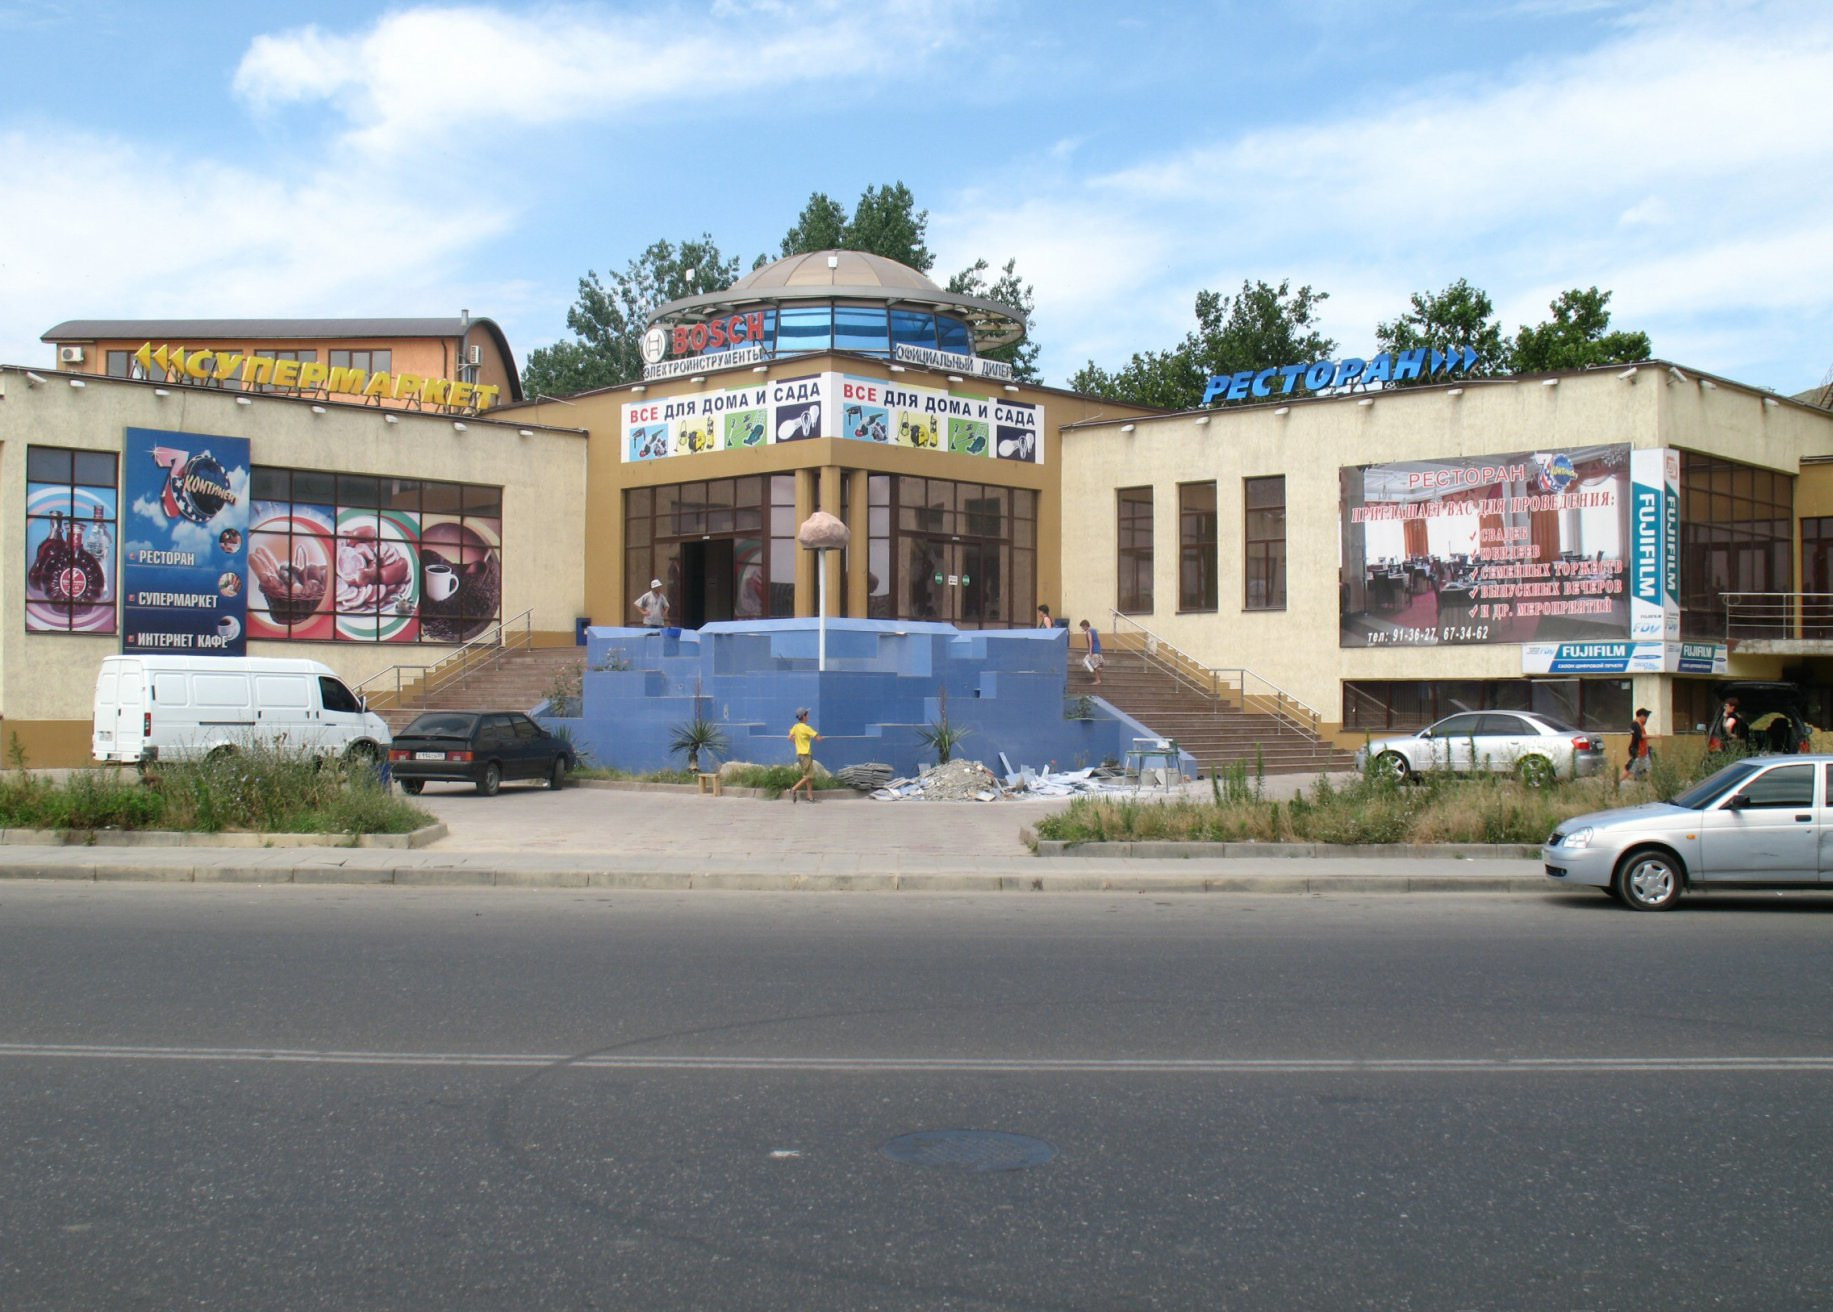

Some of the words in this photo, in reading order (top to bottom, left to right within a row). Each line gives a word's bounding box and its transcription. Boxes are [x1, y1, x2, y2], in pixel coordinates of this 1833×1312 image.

[673, 312, 764, 354] BOSCH
[643, 348, 763, 379] ЭЛЕКТРОИНСТРУМЕНТЫ
[896, 346, 974, 372] ОФИЦИАЛЬНЫЙ
[981, 360, 1012, 378] ДИЛЕР
[185, 349, 500, 410] СУПЕРМАРКЕТ
[1201, 347, 1428, 403] РЕСТОРАН
[630, 407, 659, 424] ВСЕ
[664, 400, 696, 421] ДЛЯ
[702, 393, 749, 415] ДОМА
[756, 390, 766, 405] И
[774, 382, 821, 403] САДА
[843, 384, 877, 402] ВСЕ
[884, 390, 918, 408] ДЛЯ
[925, 396, 972, 416] ДОМА
[978, 404, 988, 419] И
[994, 408, 1035, 427] САДА
[1408, 464, 1526, 489] РЕСТОРАН
[1351, 501, 1443, 523] ПРИГЛАШАЕТ
[1446, 500, 1474, 516] ВАС
[1479, 497, 1506, 518] ДЛЯ
[1510, 491, 1615, 514] ПРОВЕДЕНИЯ:
[1480, 526, 1528, 543] СВАДЕБ
[1639, 493, 1656, 597] FUJIFILM
[1667, 496, 1676, 591] FUJIFILM
[139, 550, 195, 565] РЕСТОРАН
[1480, 545, 1541, 560] ЮБИЛЕЕВ
[1480, 562, 1551, 580] СЕМЕЙНЫХ
[1552, 559, 1623, 577] ТОРЖЕСТВ
[138, 592, 218, 608] СУПЕРМАРКЕТ
[1480, 581, 1560, 599] ВЫПУСКНЫХ
[1563, 579, 1623, 596] ВЕЧЕРОВ
[1480, 604, 1489, 618] И
[1492, 603, 1513, 621] ДР.
[1517, 596, 1613, 617] МЕРОПРИЯТИЙ
[138, 633, 193, 648] ИНТЕРНЕТ
[197, 634, 228, 648] КАФЕ
[1367, 631, 1389, 643] тел:
[1393, 627, 1439, 643] 91-36-27,
[1443, 625, 1489, 641] 67-34-62
[1562, 645, 1626, 657] FUJIFILM
[1683, 644, 1713, 658] FUJIFILM
